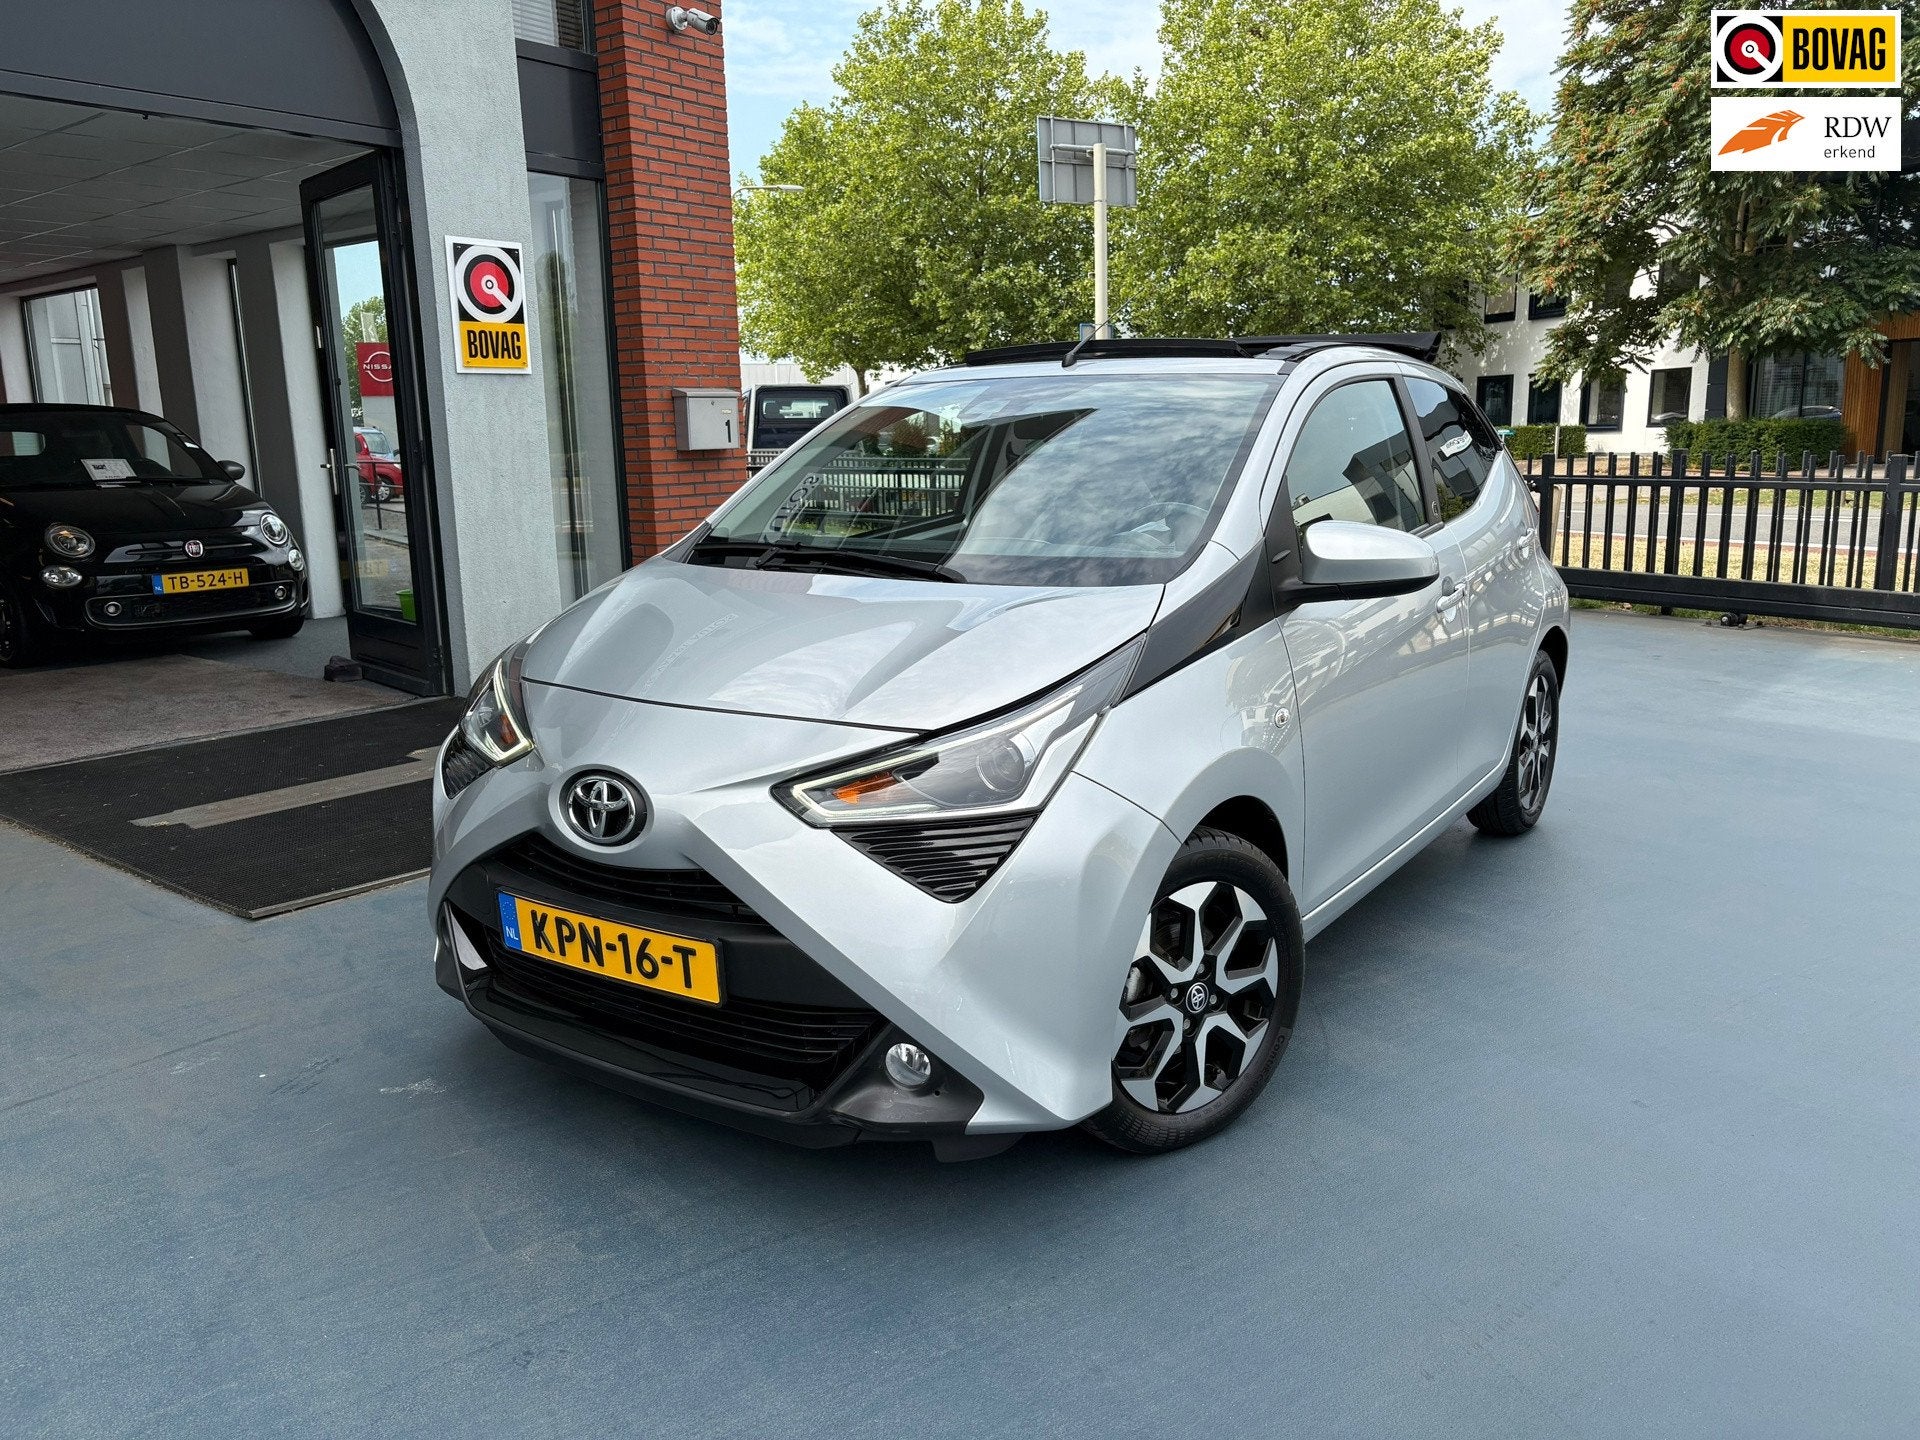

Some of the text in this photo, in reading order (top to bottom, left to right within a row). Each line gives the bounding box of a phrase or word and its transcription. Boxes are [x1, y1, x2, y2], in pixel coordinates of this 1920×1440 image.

[467, 329, 521, 360] BOVAG
[725, 419, 732, 443] 1
[168, 571, 243, 590] TB-524-H
[506, 909, 697, 989] NL KPN-16-T
